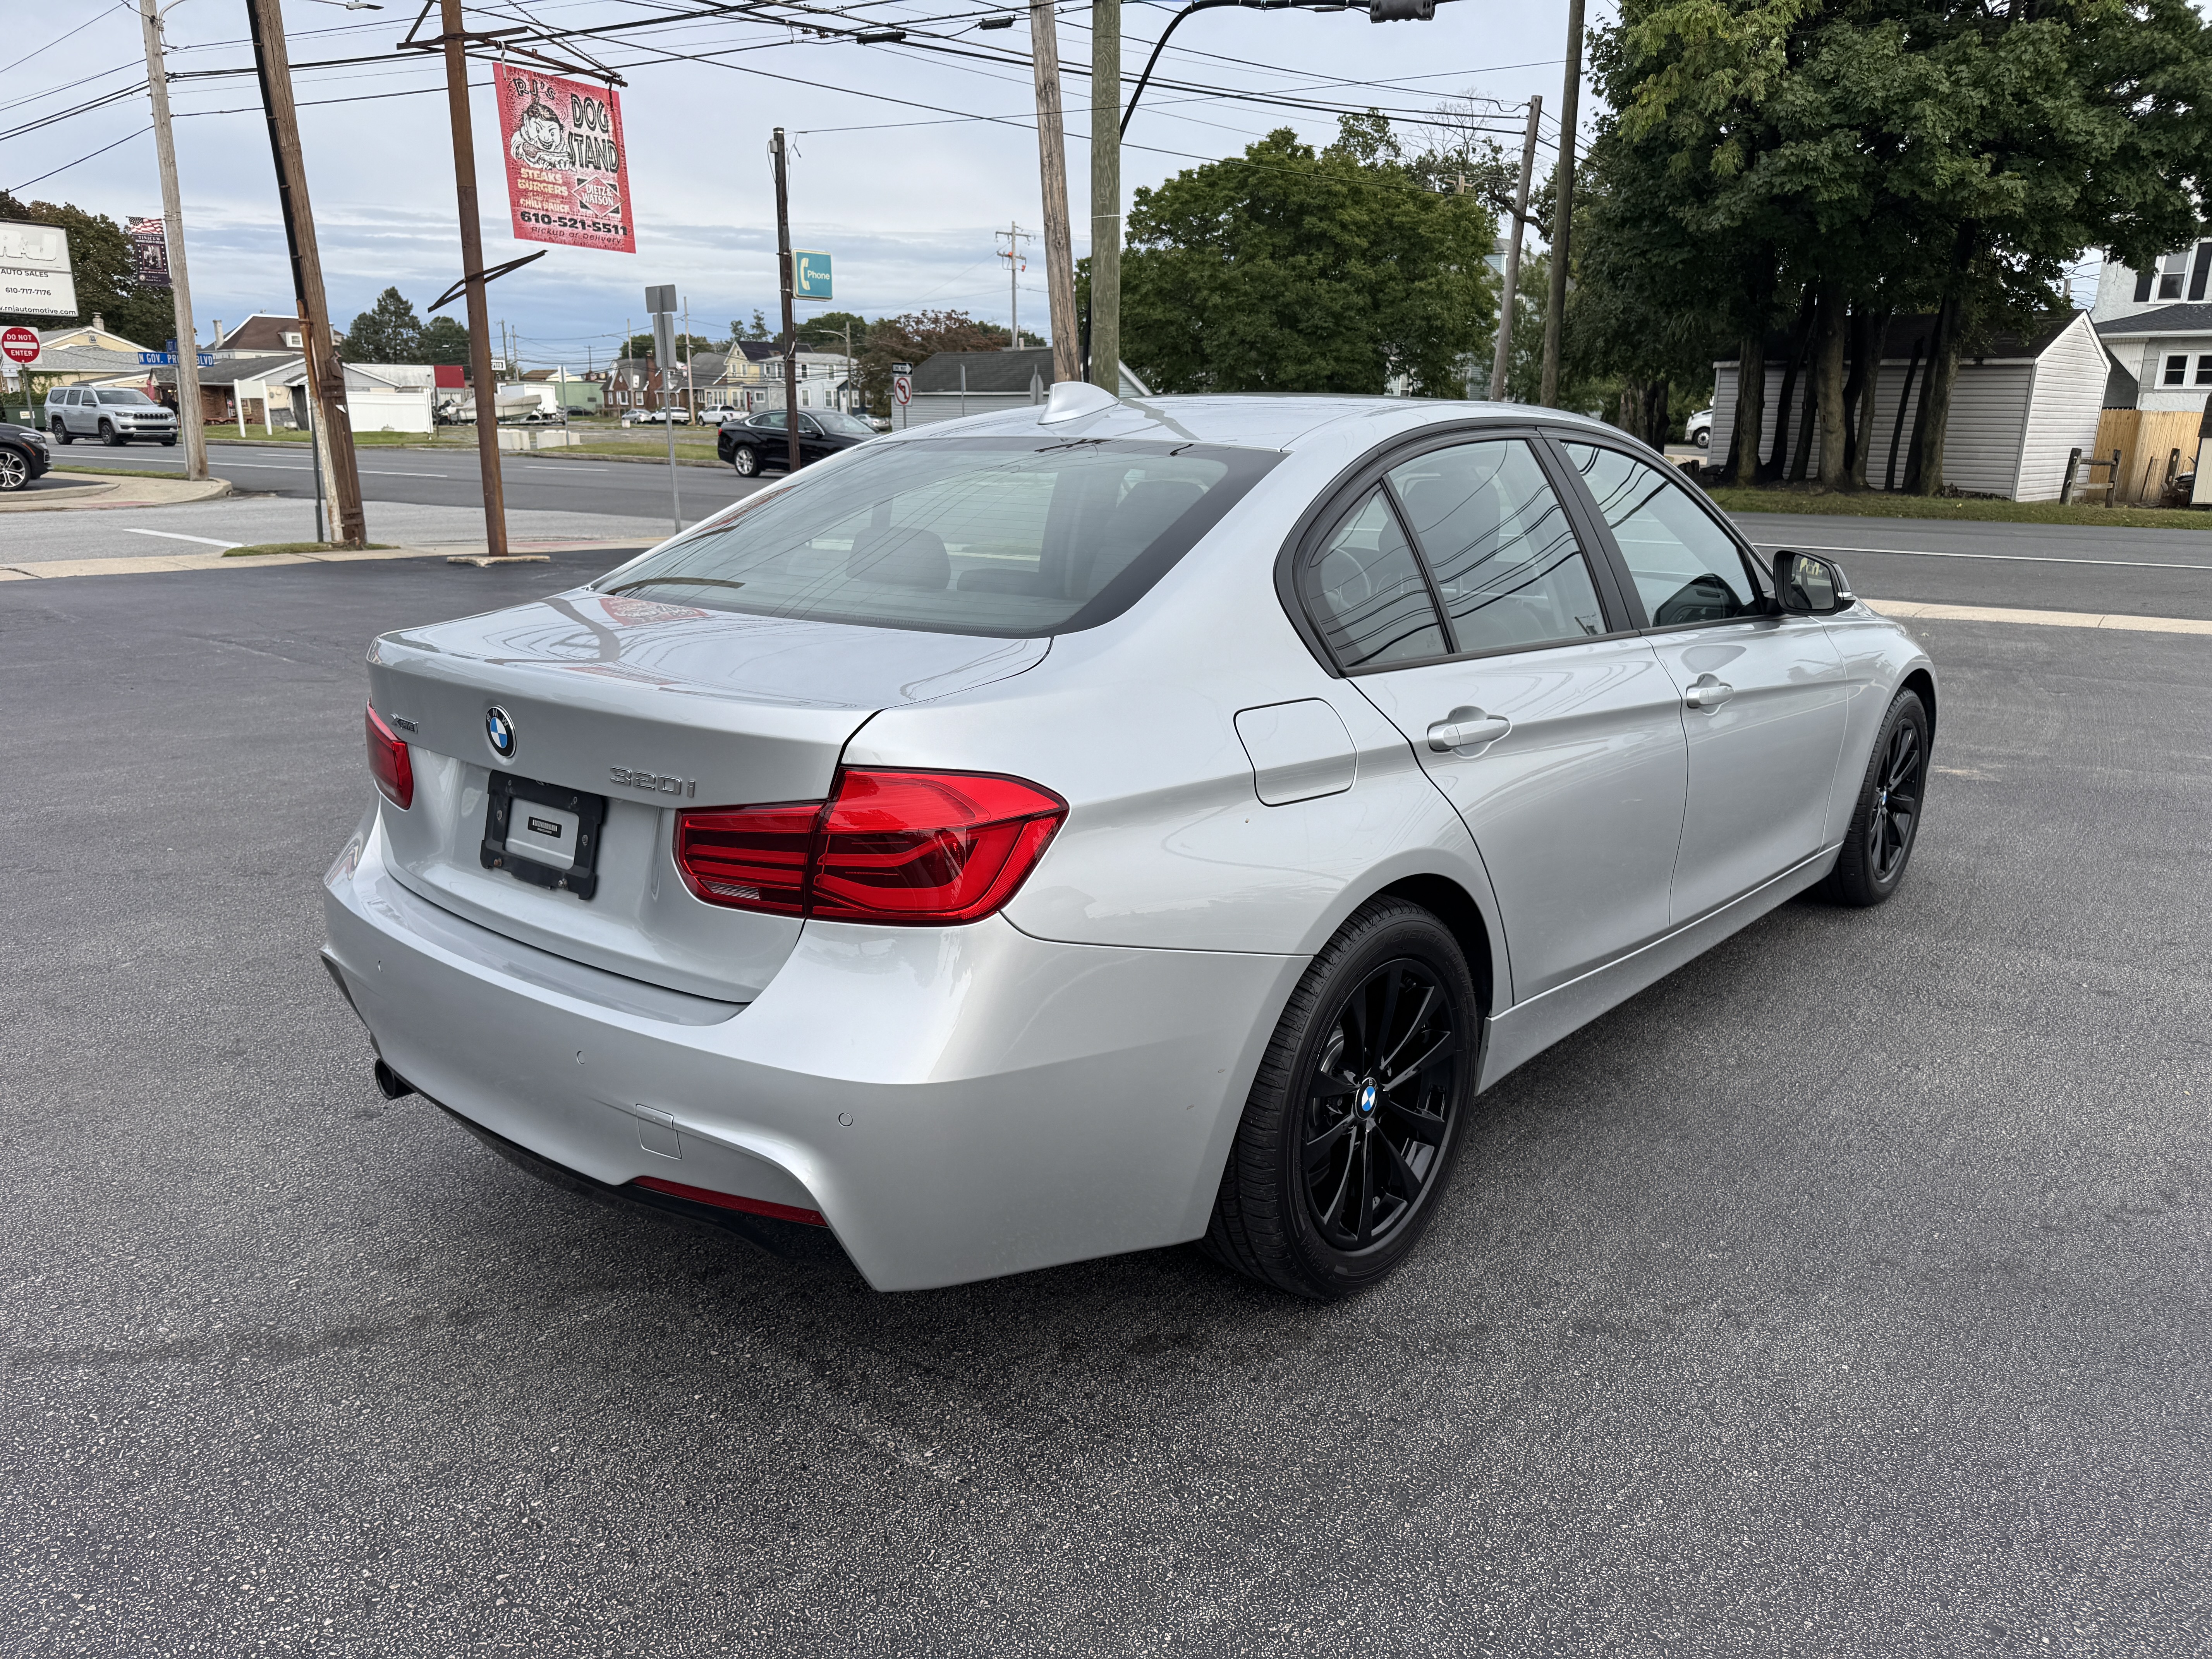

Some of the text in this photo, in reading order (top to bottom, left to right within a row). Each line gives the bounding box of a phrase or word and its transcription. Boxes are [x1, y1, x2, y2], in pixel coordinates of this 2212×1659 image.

[571, 92, 609, 133] DOG
[568, 131, 619, 173] STAND
[520, 168, 562, 184] STEAKS
[517, 179, 568, 196] BURGERS
[582, 192, 614, 206] WATSON
[543, 202, 570, 213] SAUCE
[520, 211, 627, 235] 610-521-5511
[807, 270, 830, 280] Phone
[5, 287, 51, 296] 610-717-7176
[139, 353, 213, 365] N GOV. PRI BLVD
[486, 708, 508, 726] BMW
[610, 767, 696, 798] 320i
